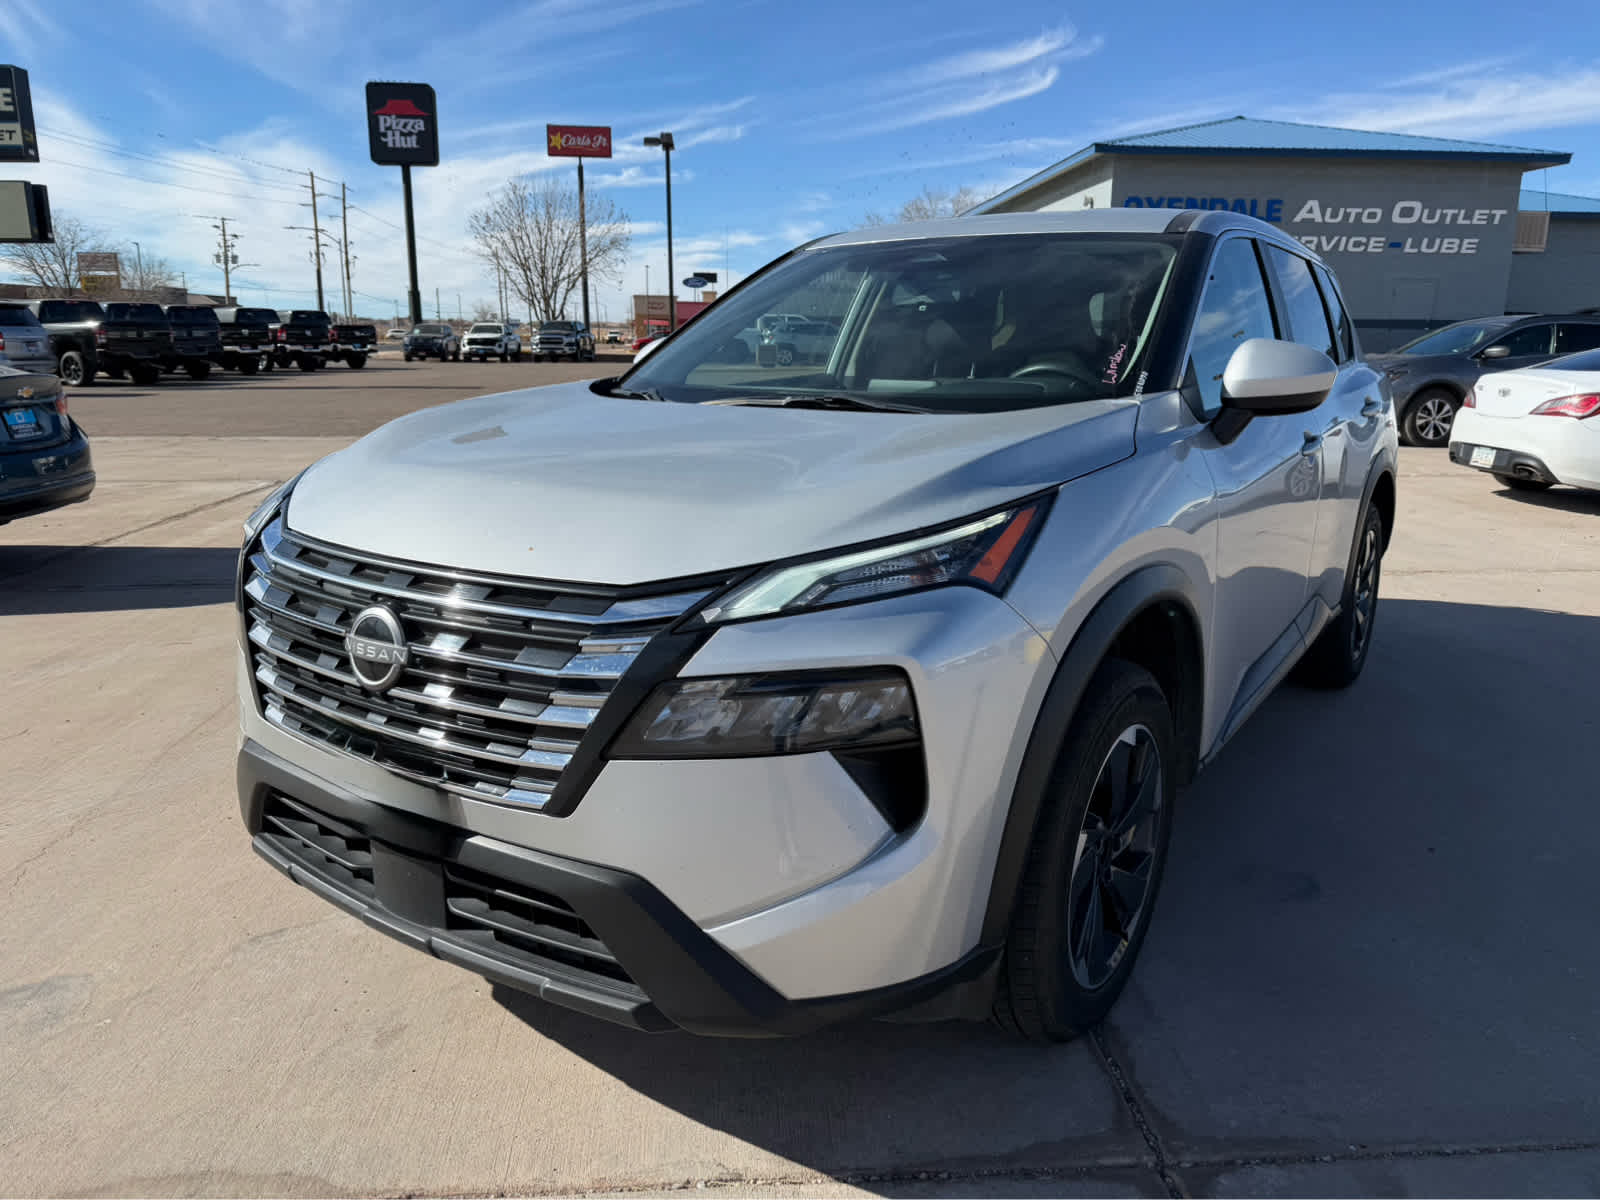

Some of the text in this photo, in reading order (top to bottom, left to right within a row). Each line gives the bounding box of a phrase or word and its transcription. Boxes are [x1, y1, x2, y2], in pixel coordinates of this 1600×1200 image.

[378, 114, 425, 133] Pizza
[380, 130, 420, 148] Hut
[1292, 199, 1383, 223] AUTO
[1391, 200, 1508, 225] OUTLET
[345, 636, 407, 662] NISSAN
